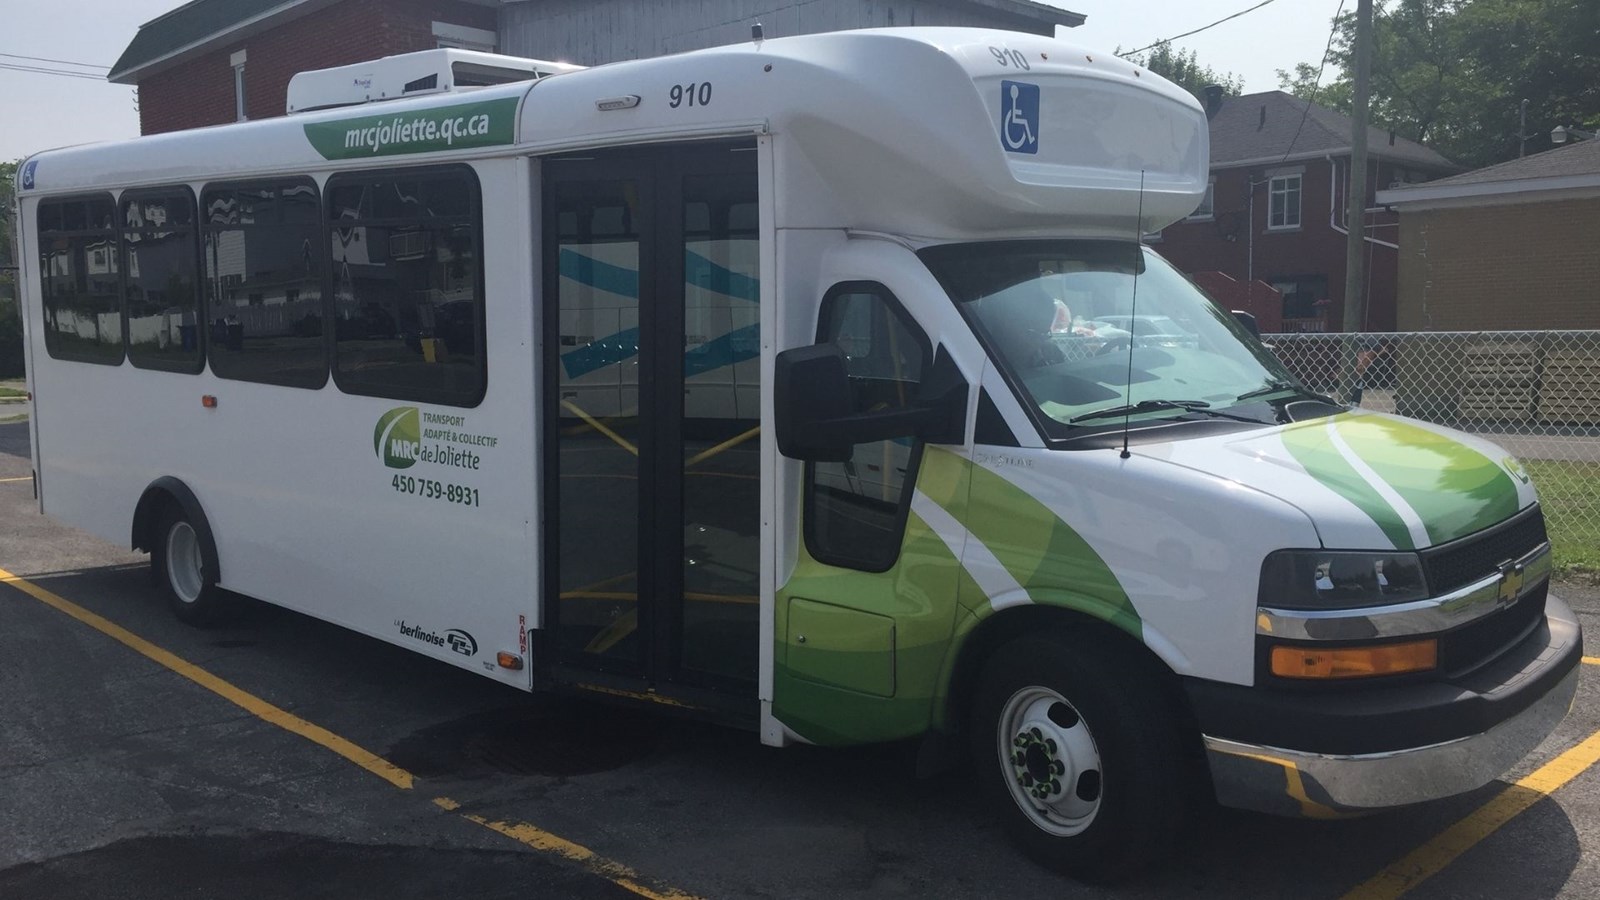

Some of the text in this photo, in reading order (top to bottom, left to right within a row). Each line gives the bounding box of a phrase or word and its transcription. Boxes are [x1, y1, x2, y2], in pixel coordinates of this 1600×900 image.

[988, 46, 1030, 71] 910
[669, 81, 712, 109] 910
[344, 113, 489, 152] mrcjoliette.qc.ca
[423, 412, 465, 427] TRANSPORT
[391, 438, 420, 460] MRC
[423, 428, 498, 448] ADAPTÉ & COLLECTIF
[392, 474, 479, 507] 450 759-8931
[400, 620, 445, 647] berlinoise
[519, 614, 527, 655] RAMP
